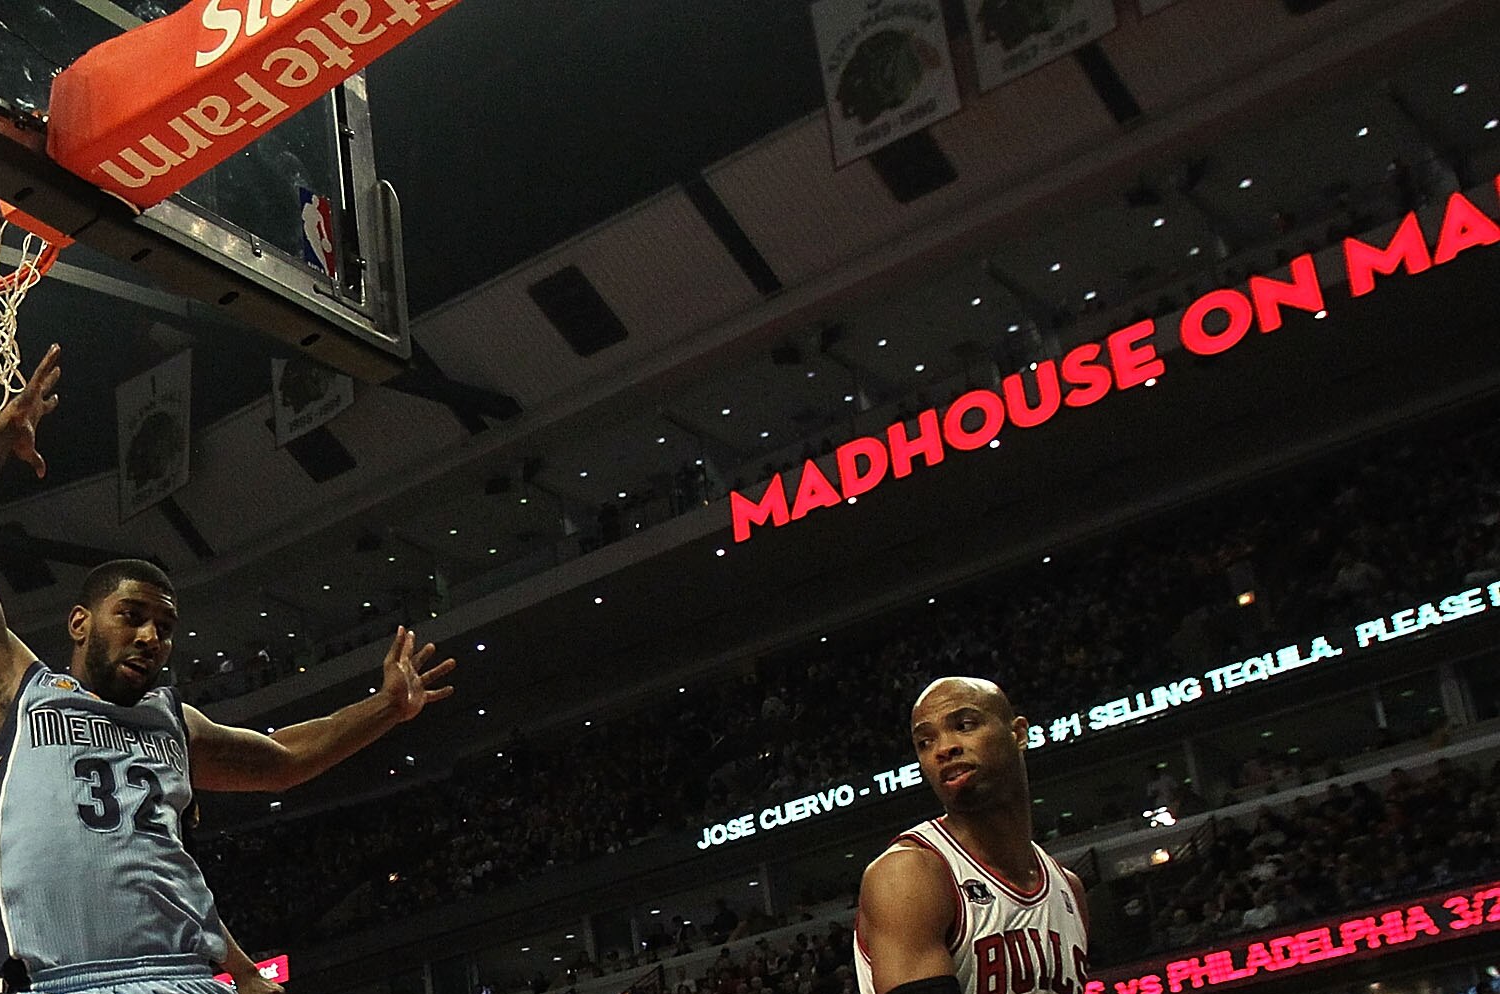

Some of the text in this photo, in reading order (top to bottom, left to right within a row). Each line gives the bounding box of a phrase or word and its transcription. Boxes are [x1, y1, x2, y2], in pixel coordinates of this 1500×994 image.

[262, 0, 457, 88] tate
[730, 175, 1500, 542] MADHOUSE ON MA
[29, 707, 185, 776] MEMPHIS
[695, 814, 756, 850] JOSE
[759, 784, 855, 830] CUERVO
[873, 762, 923, 796] THE
[1049, 712, 1082, 743] #1
[1088, 675, 1203, 731] SELLING
[1204, 636, 1343, 694] TEQUILA.
[1354, 586, 1486, 648] PLEASE
[73, 756, 172, 842] 32
[1166, 905, 1441, 993] PHILADELPHIA
